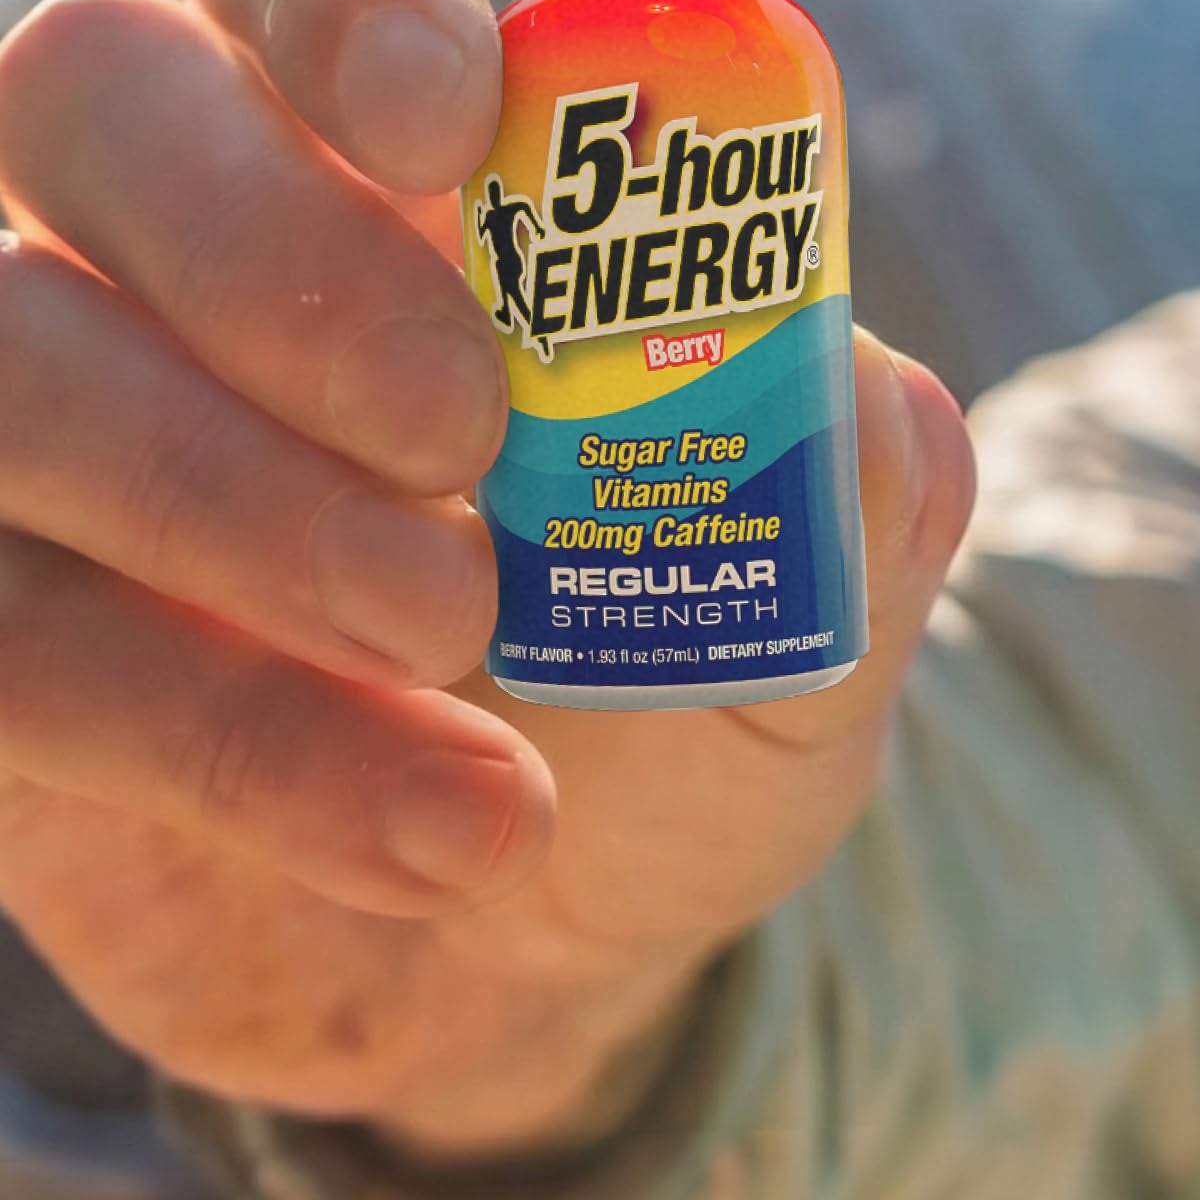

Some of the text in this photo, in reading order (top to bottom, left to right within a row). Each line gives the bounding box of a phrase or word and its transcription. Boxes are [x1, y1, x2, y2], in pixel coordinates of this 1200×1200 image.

[552, 94, 817, 234] 5-hour
[646, 331, 722, 367] Berry
[579, 432, 746, 470] Sugar Free
[593, 475, 727, 508] Vitamins
[545, 515, 780, 554] 200mg Caffeine
[549, 559, 776, 595] REGULAR
[551, 598, 778, 628] STRENGTH
[529, 647, 573, 663] FLAVOR
[588, 649, 616, 664] 1.93
[620, 649, 629, 664] fl
[633, 652, 648, 664] oz
[652, 647, 699, 665] (57mL)
[708, 642, 763, 660] DIETARY
[767, 631, 834, 655] SUPPLEMENT
